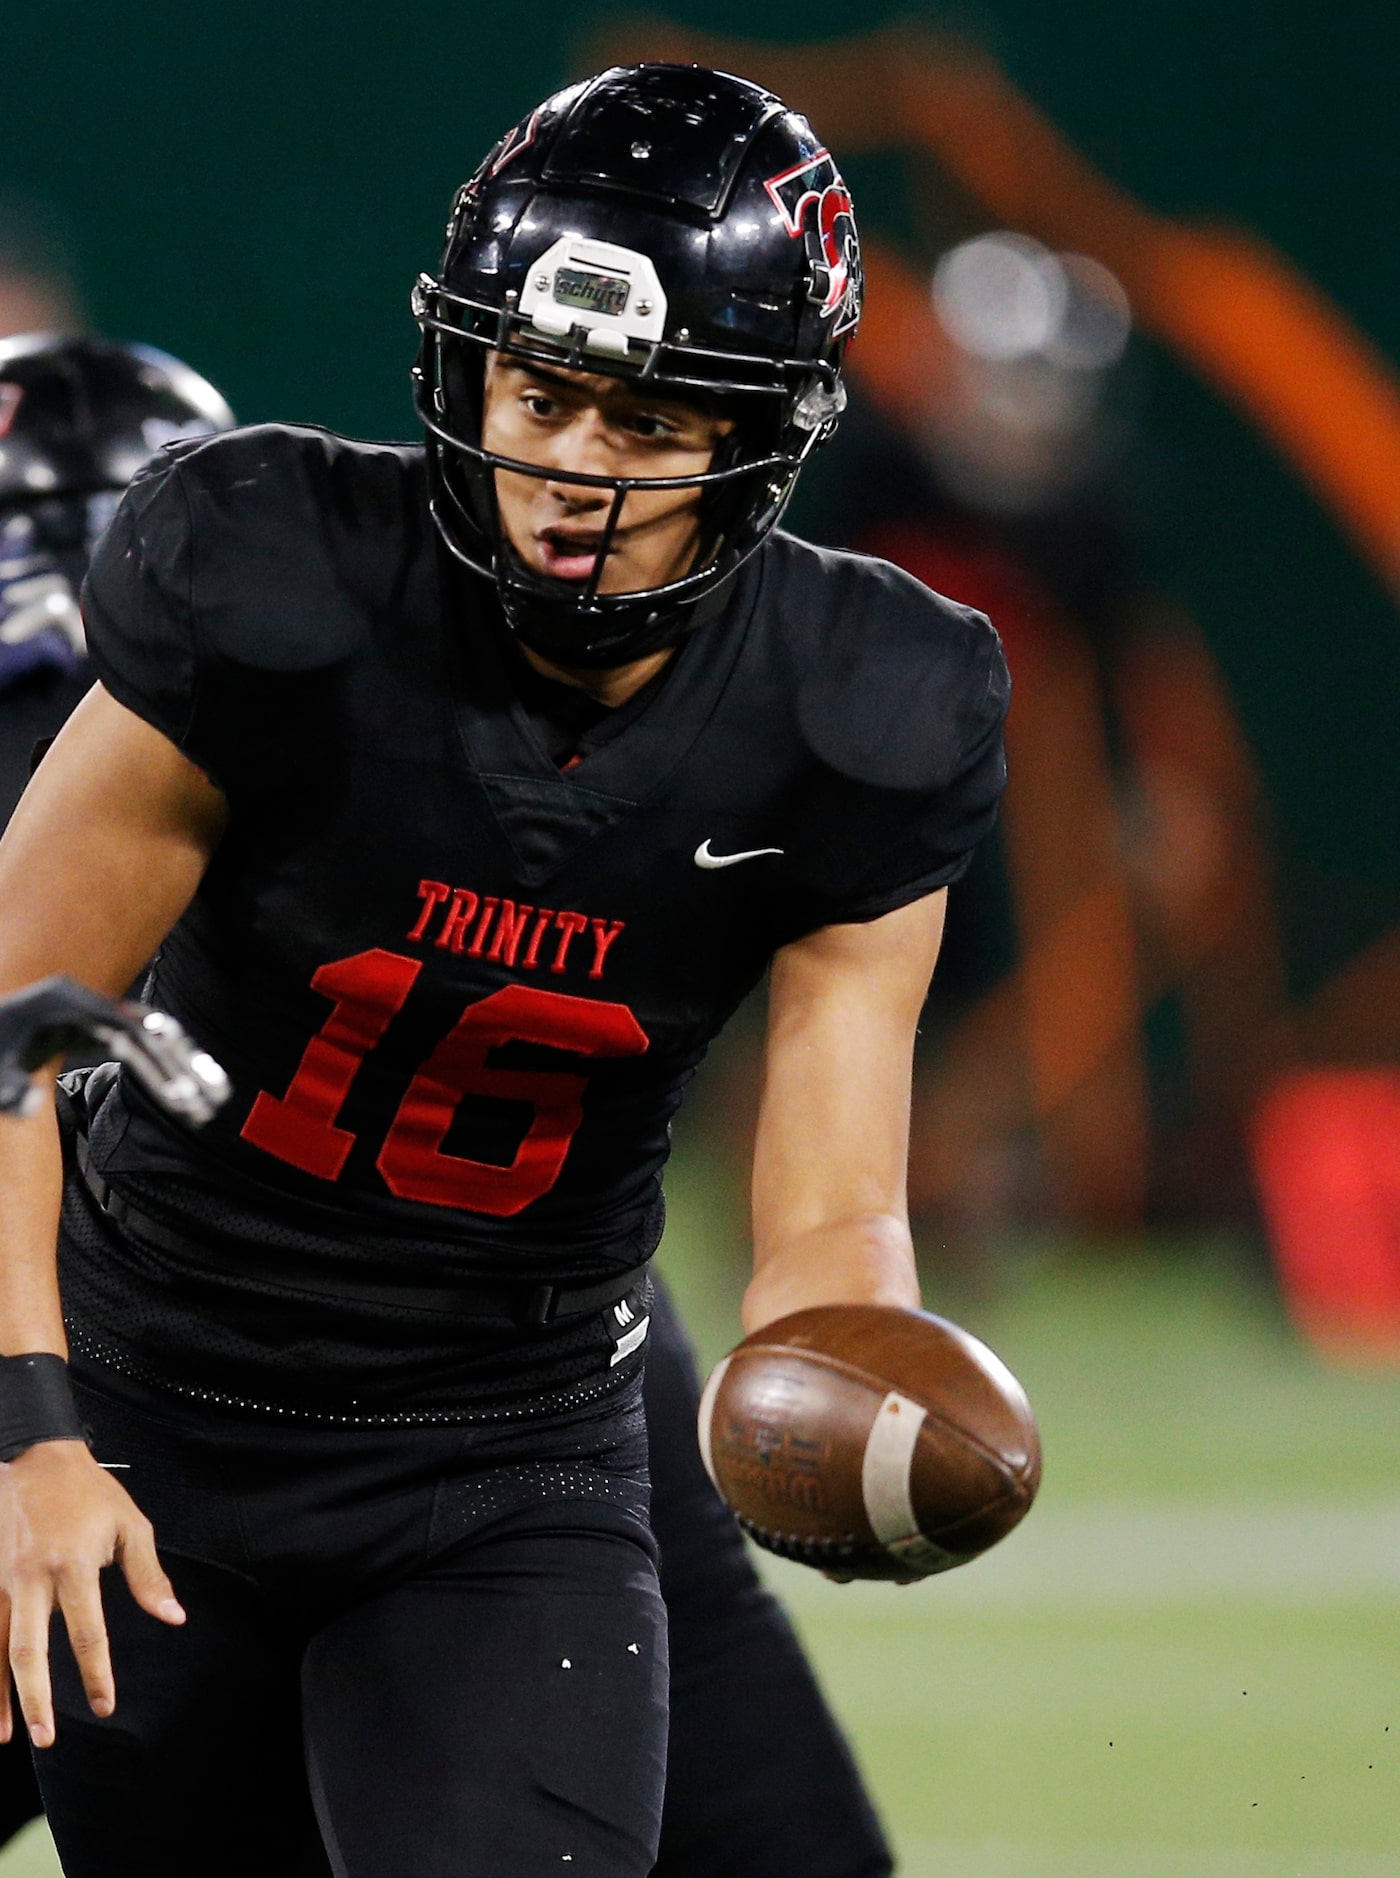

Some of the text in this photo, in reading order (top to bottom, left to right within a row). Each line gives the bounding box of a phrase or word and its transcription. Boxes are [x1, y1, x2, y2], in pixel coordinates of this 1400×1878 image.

[406, 880, 625, 980] TRINITY
[240, 948, 650, 1217] 16
[613, 1299, 635, 1327] M
